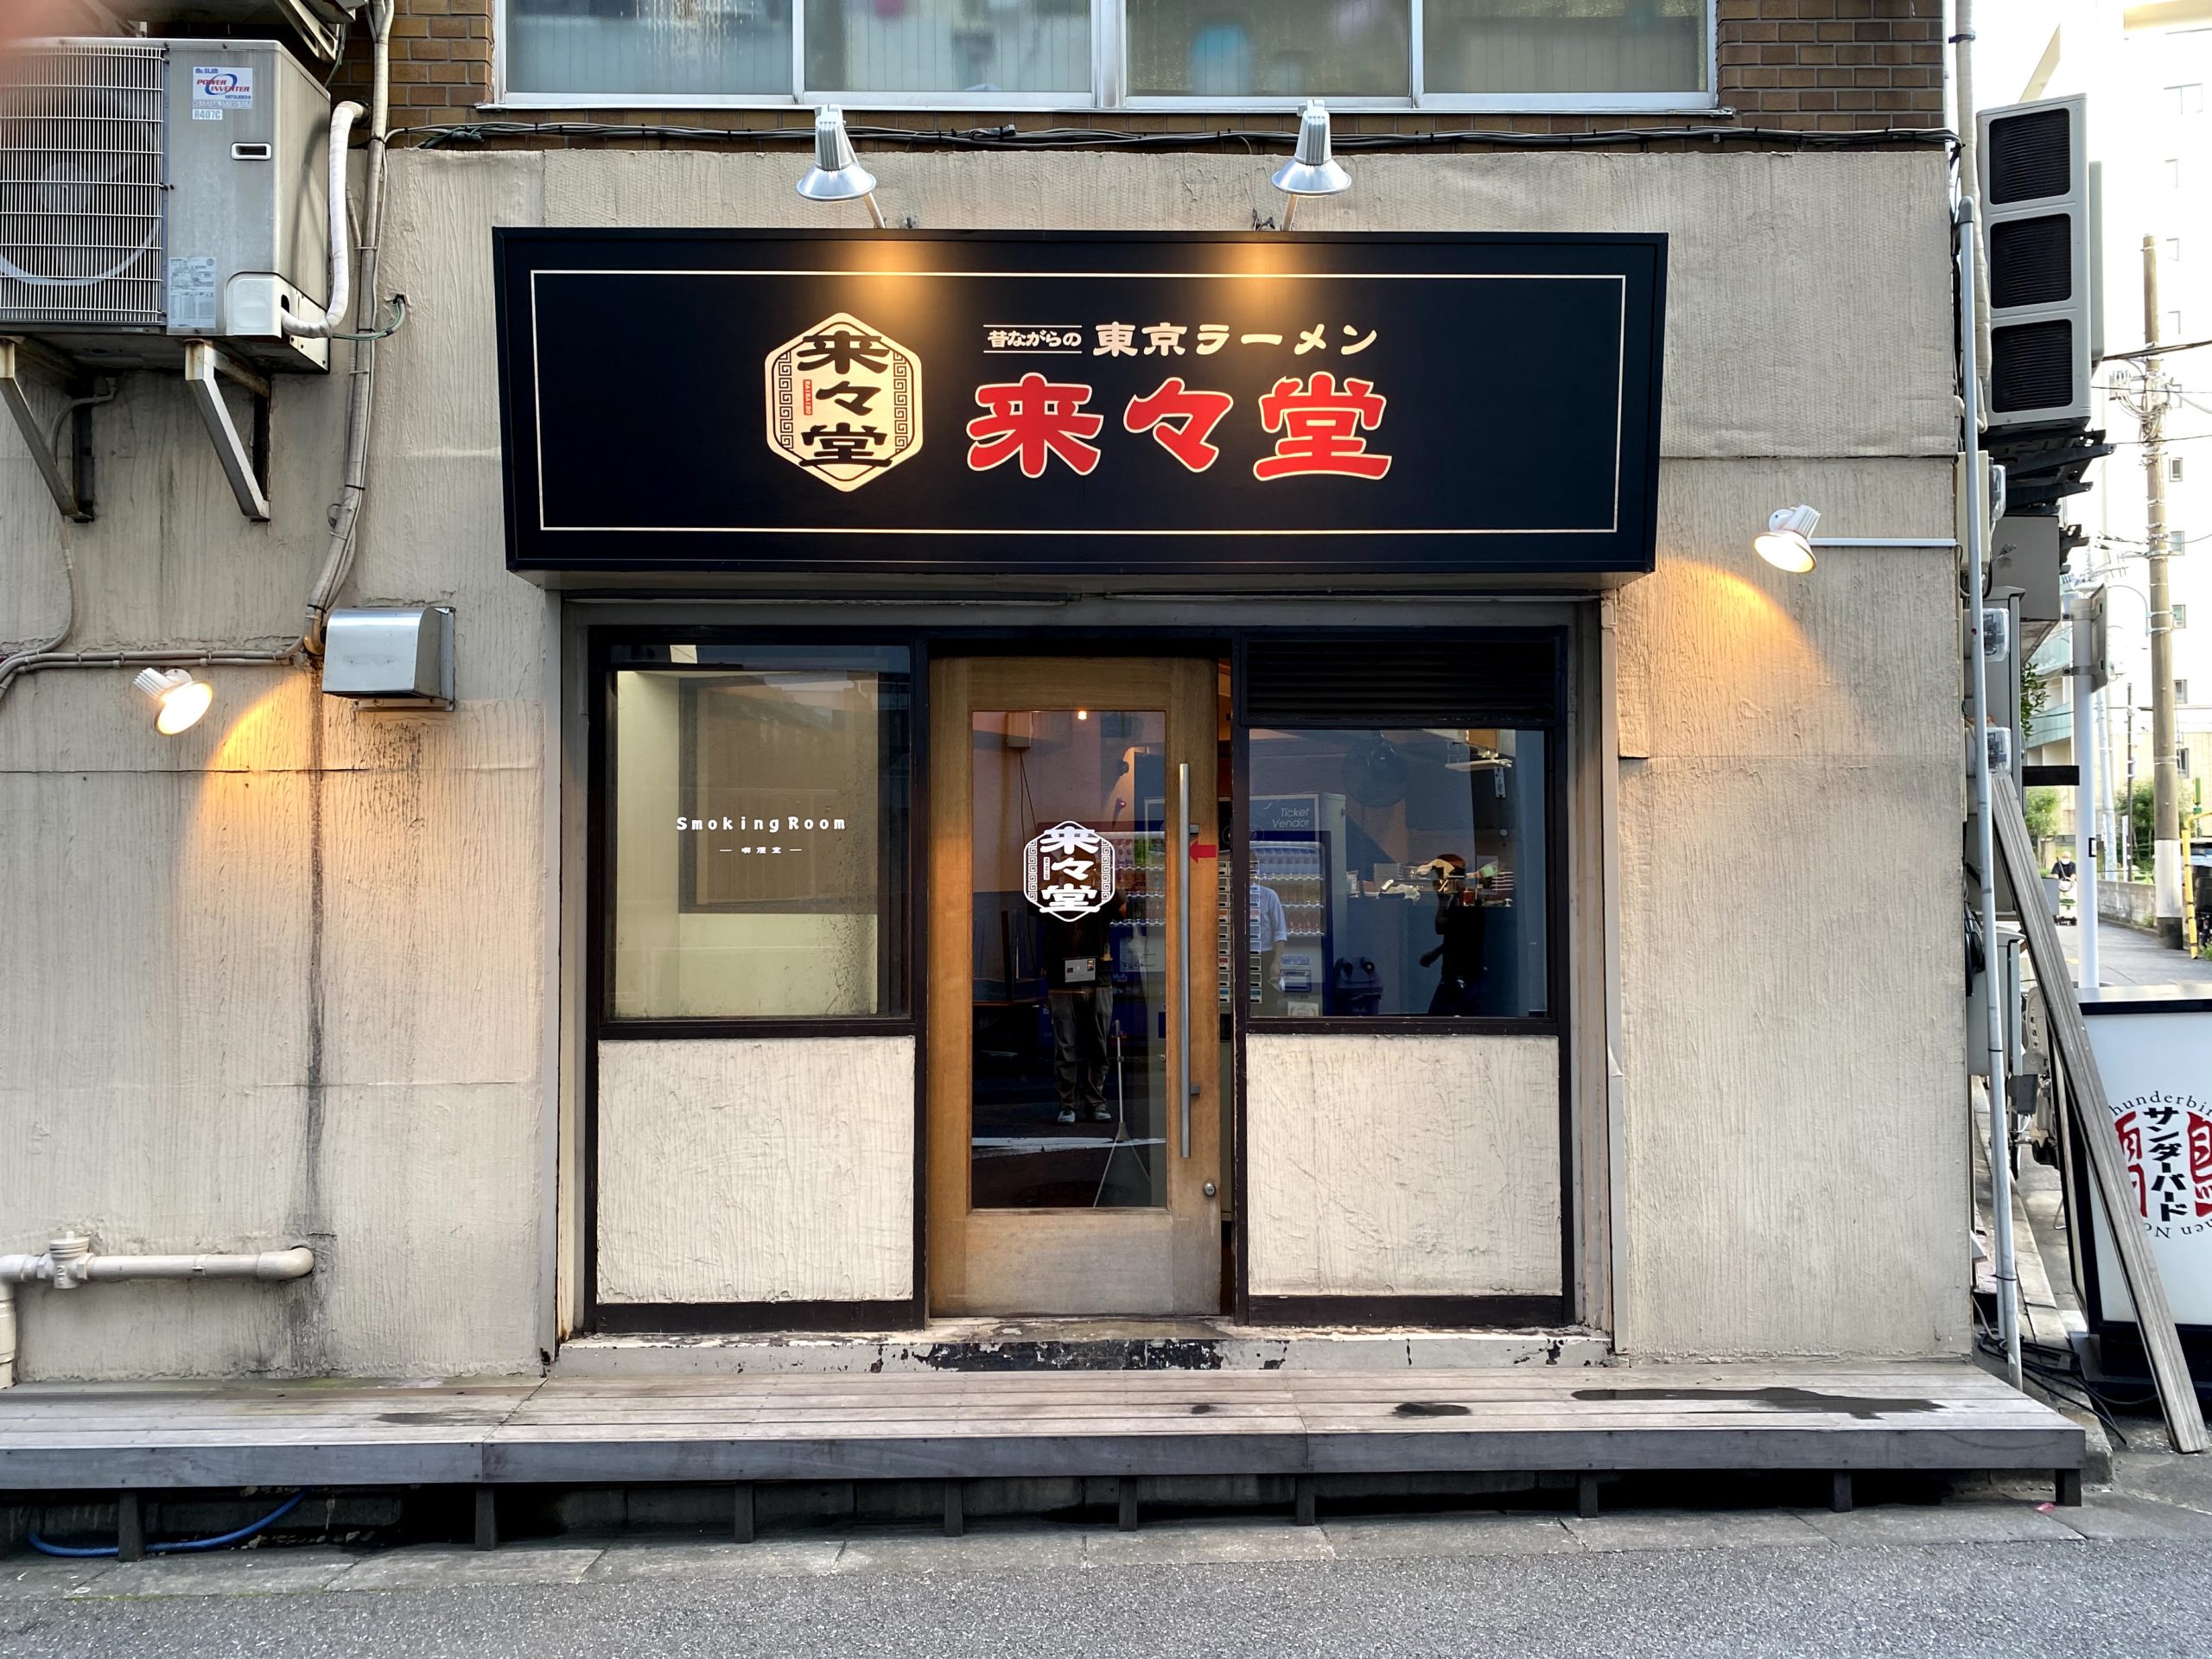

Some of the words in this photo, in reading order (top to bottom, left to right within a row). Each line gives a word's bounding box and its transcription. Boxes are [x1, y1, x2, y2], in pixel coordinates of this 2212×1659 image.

[194, 110, 221, 119] R407C
[987, 329, 1083, 349] 昔ながらの
[1092, 321, 1378, 358] 東京ラーメン
[796, 330, 893, 467] 来々堂
[966, 372, 1393, 482] 来々堂
[677, 816, 779, 833] Smoking
[787, 816, 846, 830] Room
[1272, 817, 1310, 828] Vendor
[1281, 807, 1310, 817] Ticket
[1039, 825, 1101, 913] 来々堂
[2143, 1106, 2188, 1223] サンダーバード
